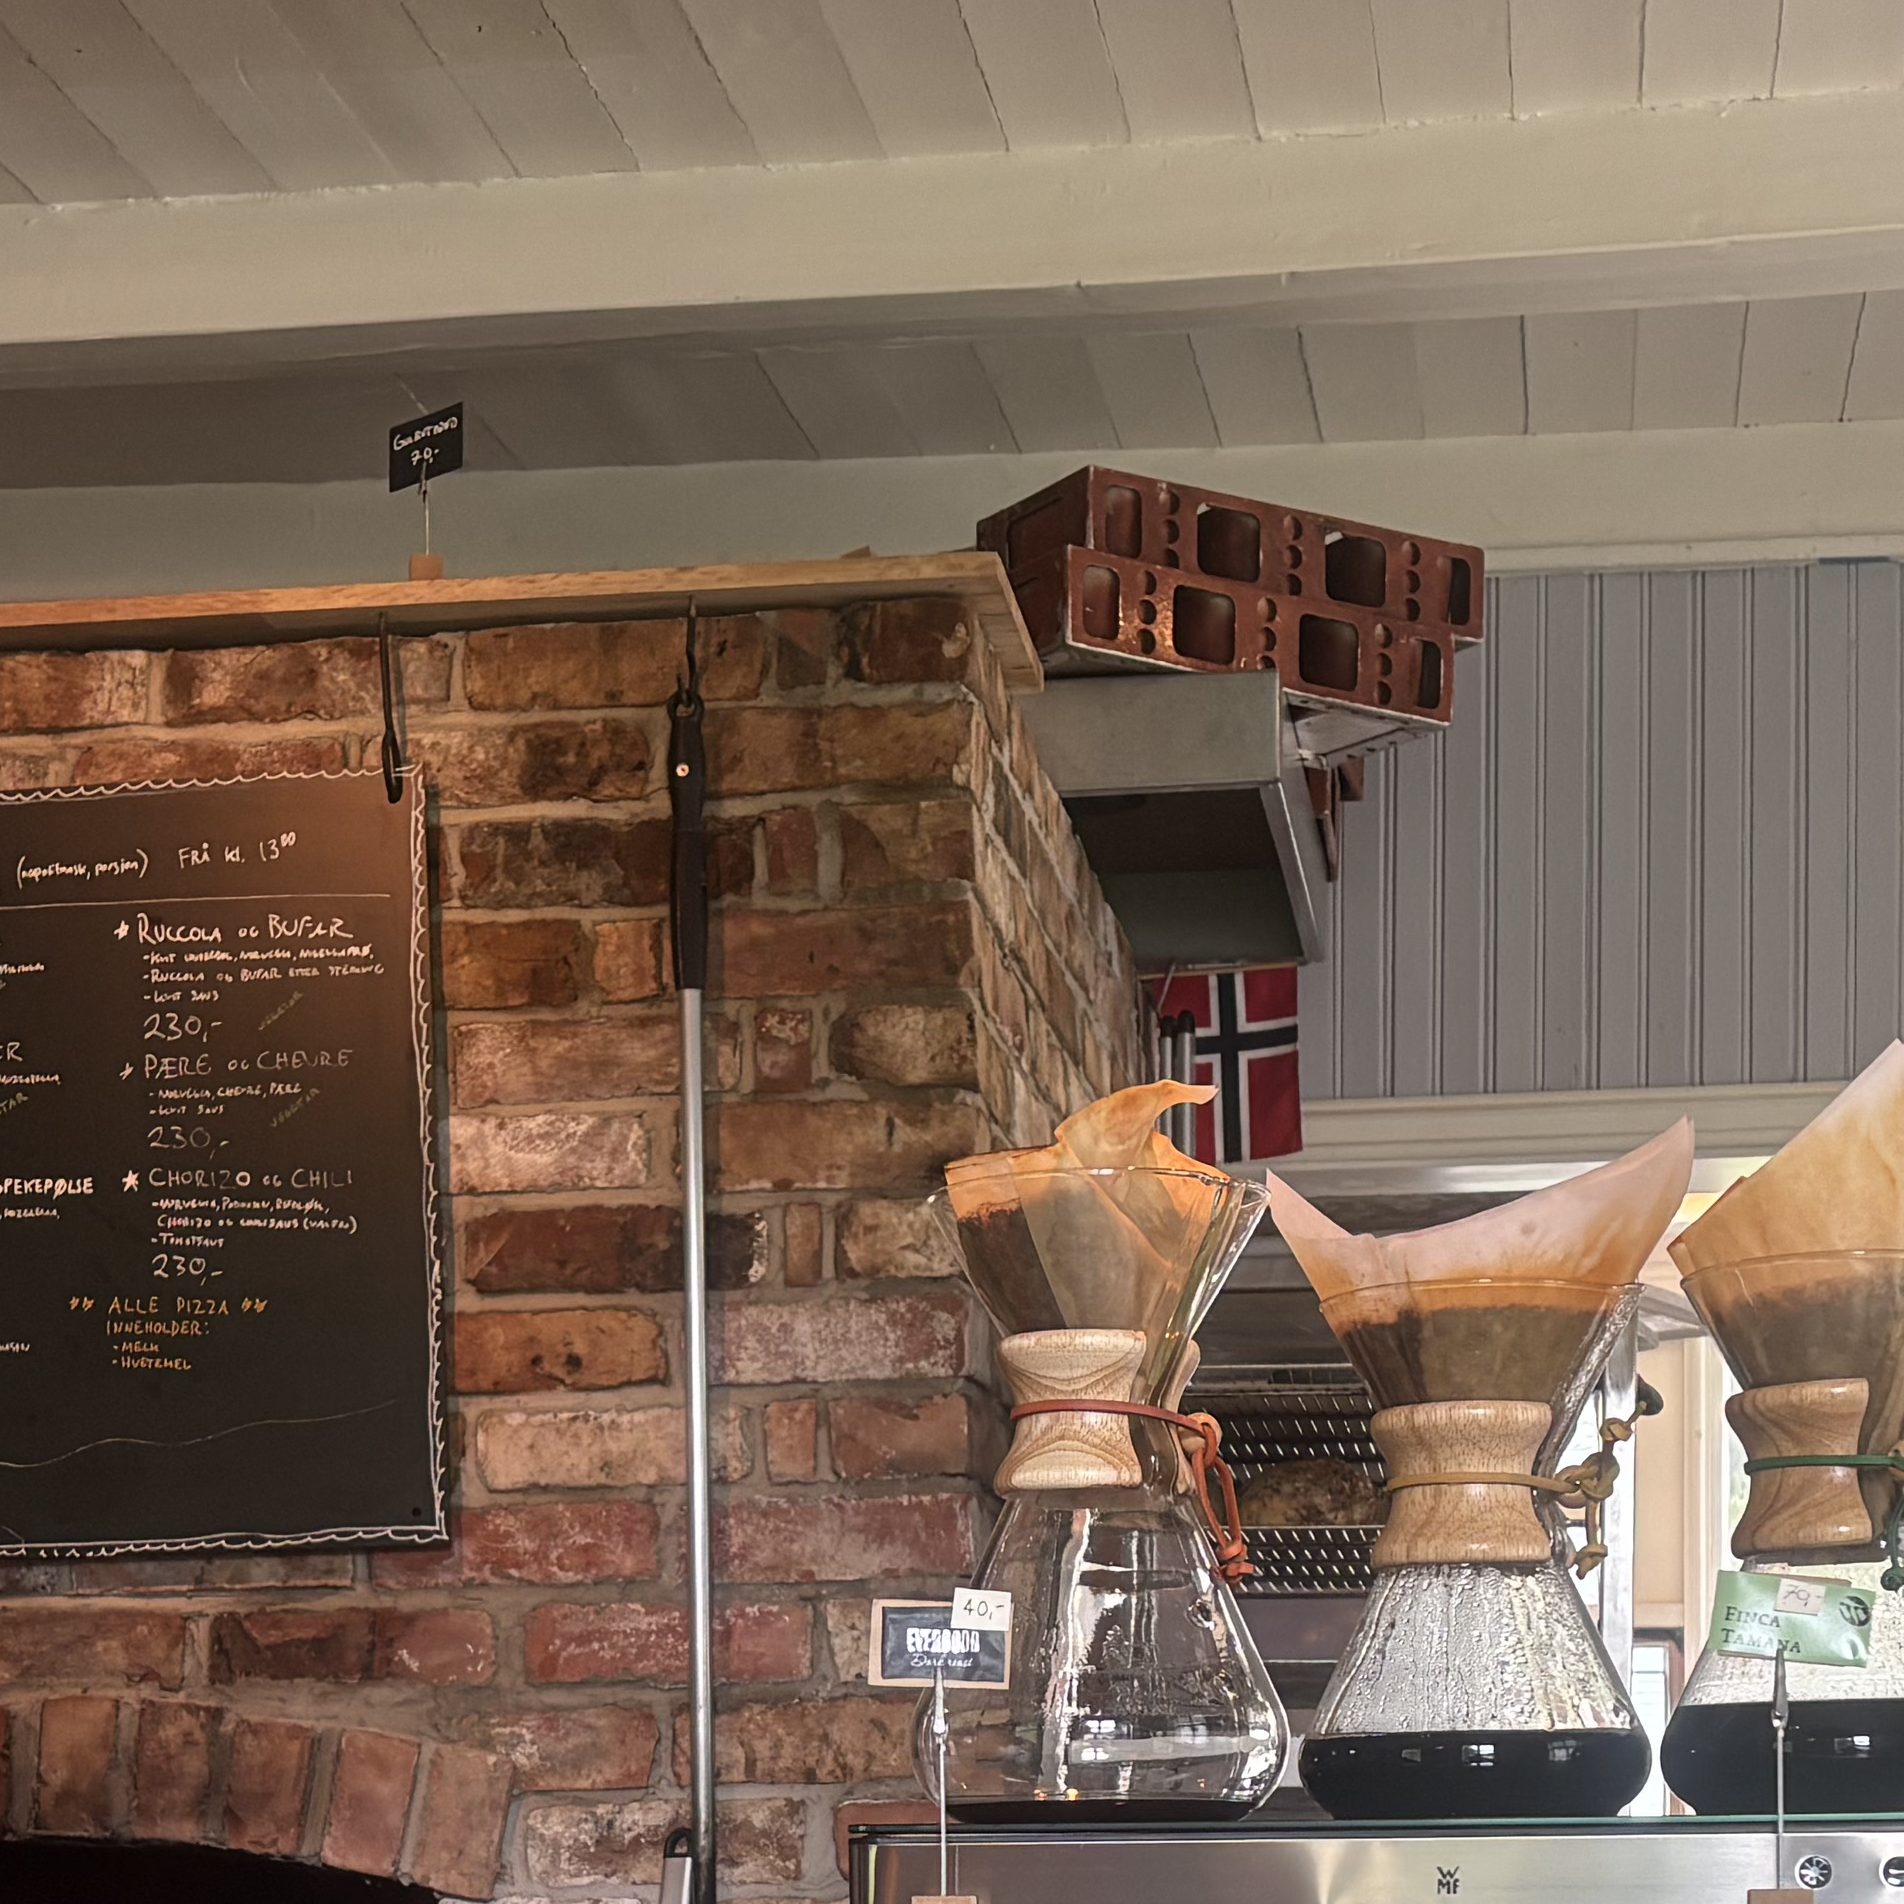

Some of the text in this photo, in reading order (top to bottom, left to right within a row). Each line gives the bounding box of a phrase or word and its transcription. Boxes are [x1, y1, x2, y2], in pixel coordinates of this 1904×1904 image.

[137, 912, 222, 945] RUCCOLA
[268, 913, 354, 939] BUFAR
[143, 1012, 223, 1043] 230,-
[145, 1053, 212, 1080] PÆRE
[256, 1048, 354, 1070] CHEVRE
[147, 1126, 230, 1160] 230,-
[148, 1167, 252, 1191] CHORIZO
[291, 1168, 354, 1190] CHILI
[151, 1254, 224, 1287] 230,-
[108, 1296, 230, 1316] ALLE PIZZA
[106, 1320, 210, 1336] INNEHOLDER:
[963, 1598, 1005, 1621] 40,-
[1724, 1606, 1781, 1628] FINCA
[1721, 1628, 1801, 1654] TAMANA
